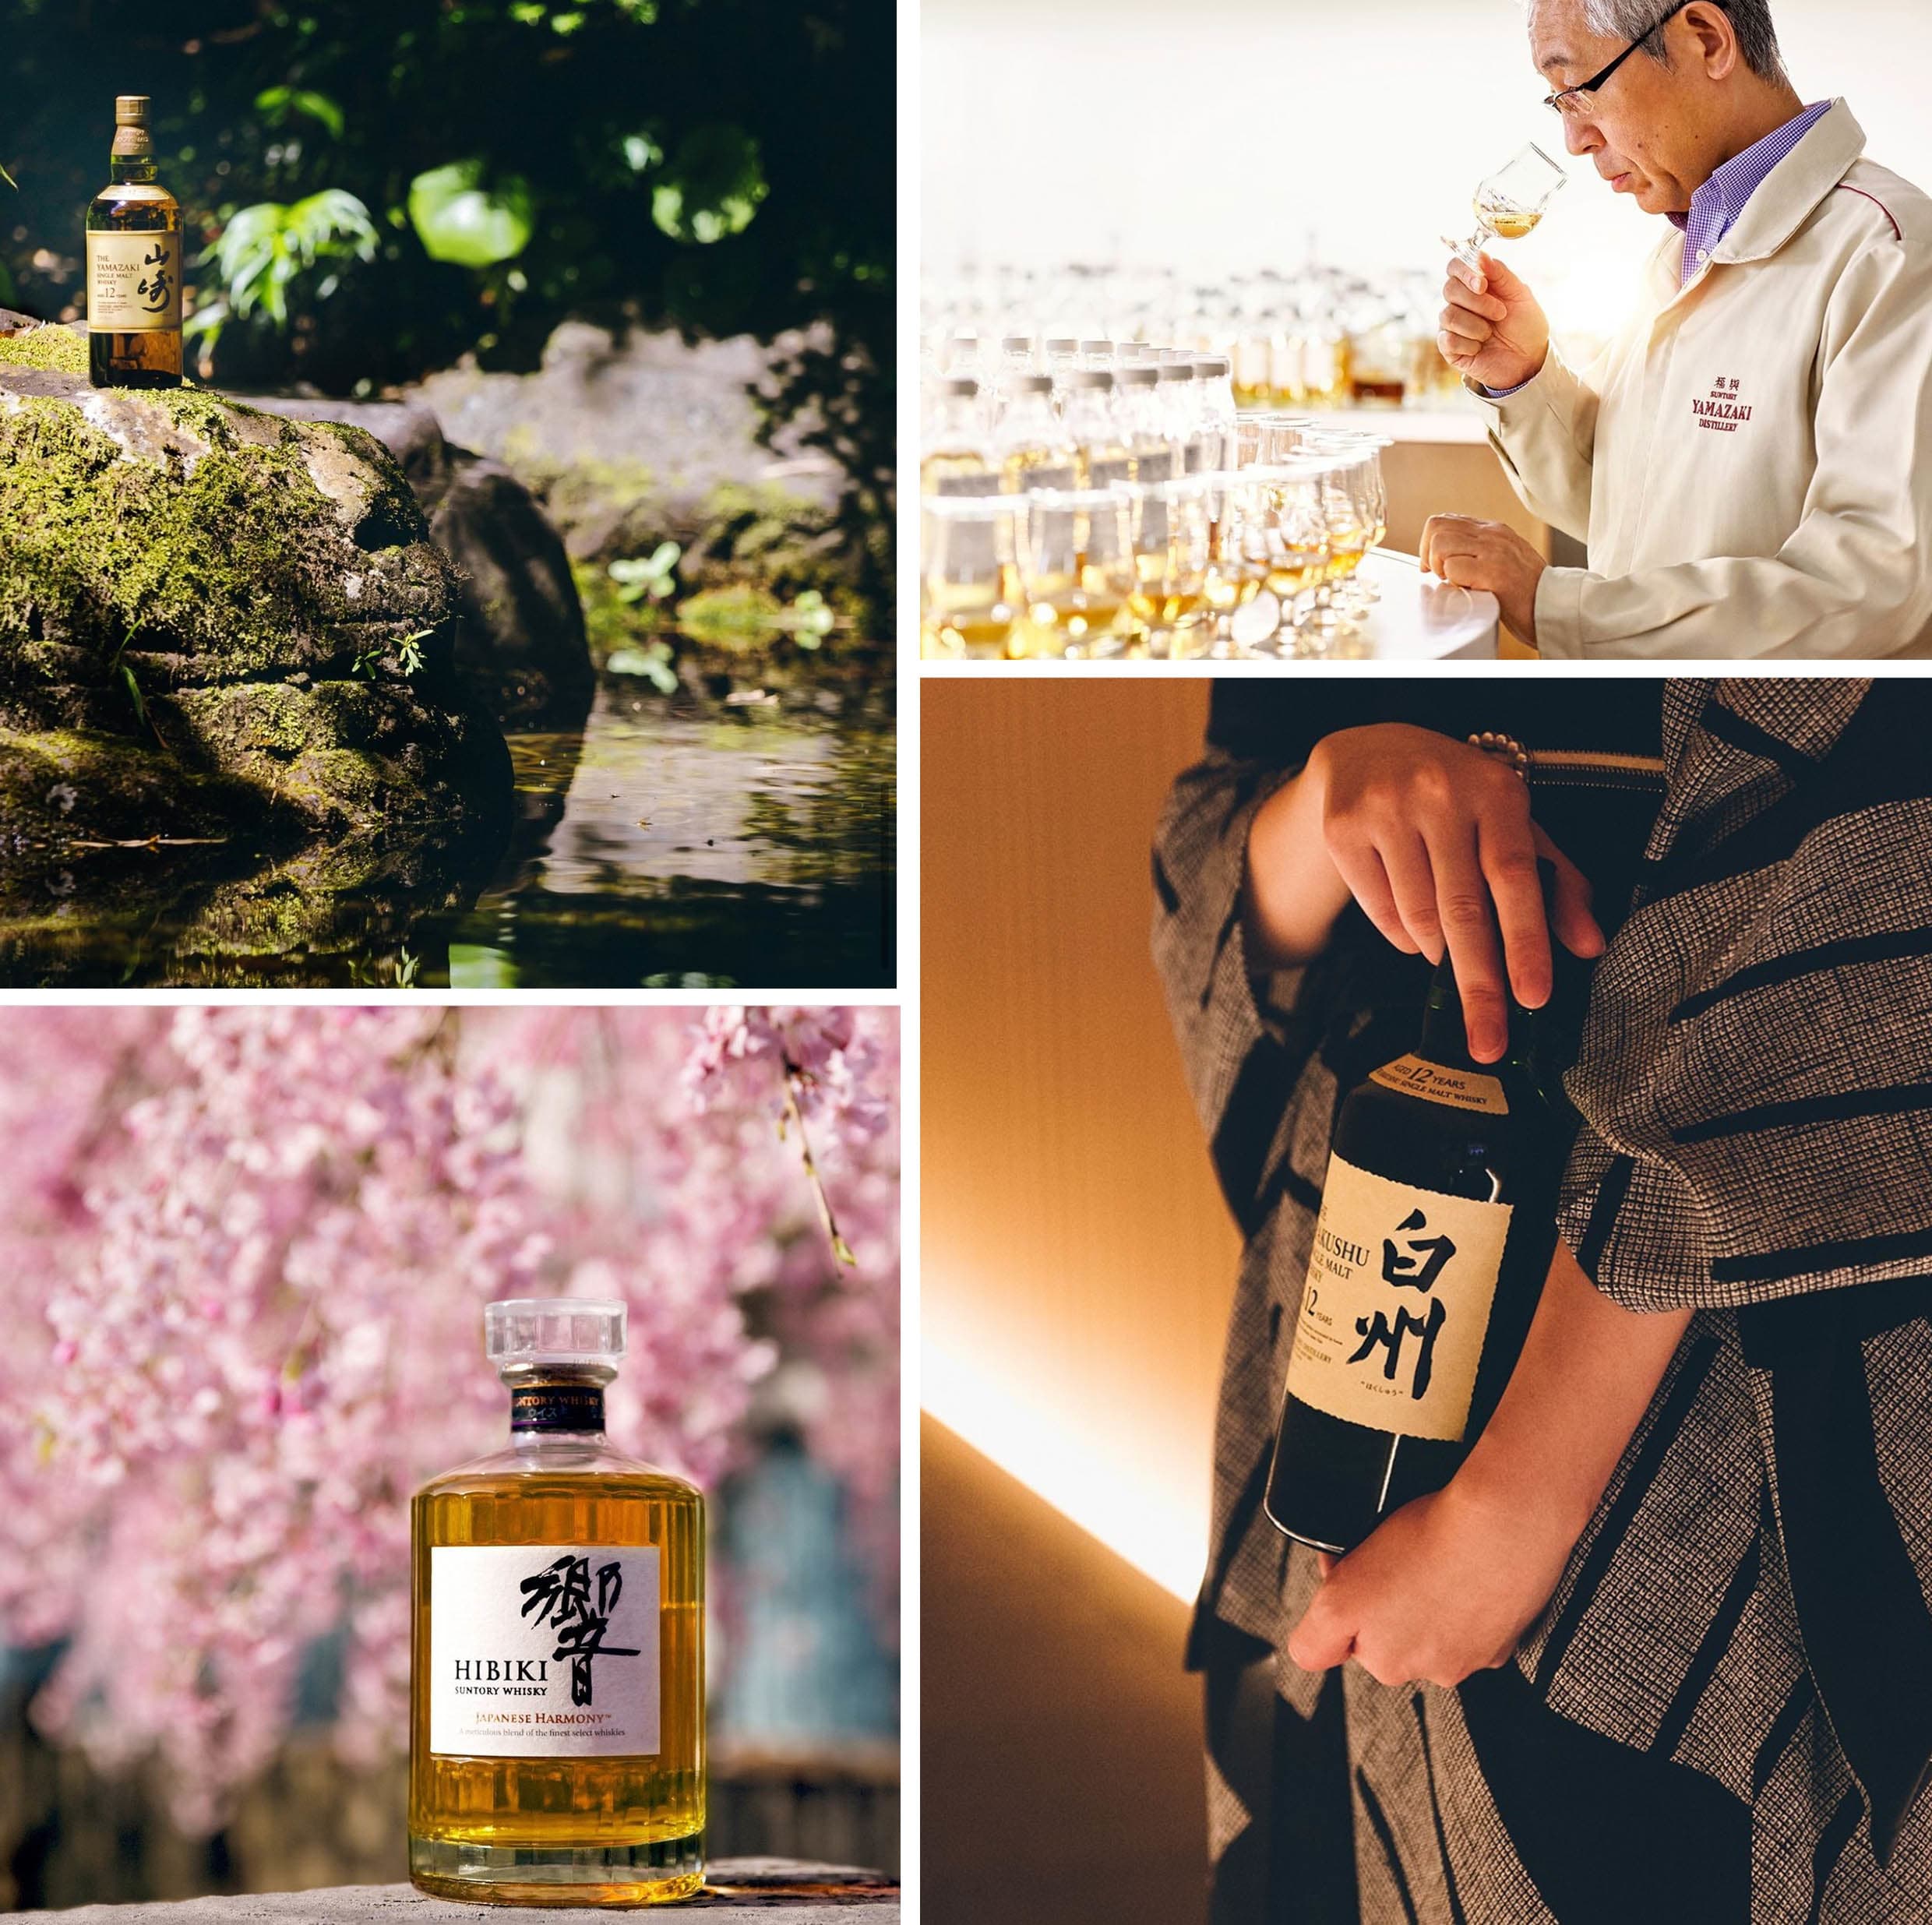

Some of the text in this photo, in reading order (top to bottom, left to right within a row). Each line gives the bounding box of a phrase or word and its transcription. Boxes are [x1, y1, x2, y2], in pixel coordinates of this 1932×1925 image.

[97, 263, 140, 272] YAMAZAKI
[138, 243, 174, 313] 山崎
[105, 287, 115, 298] 12
[1693, 400, 1752, 420] YAMAZAKI
[1698, 418, 1739, 432] DISTILLERY
[1409, 1067, 1434, 1084] 12
[1433, 1077, 1466, 1090] YEARS
[1401, 1081, 1487, 1105] SINGLE MALT WHISKY
[1326, 1258, 1353, 1280] MALT
[1304, 1286, 1318, 1317] 12
[1345, 1208, 1457, 1401] 白州
[520, 1555, 642, 1706] 響
[455, 1659, 548, 1681] HIBIKI
[455, 1687, 548, 1696] SUNTORY WHISKY
[476, 1712, 531, 1724] JAPANESE
